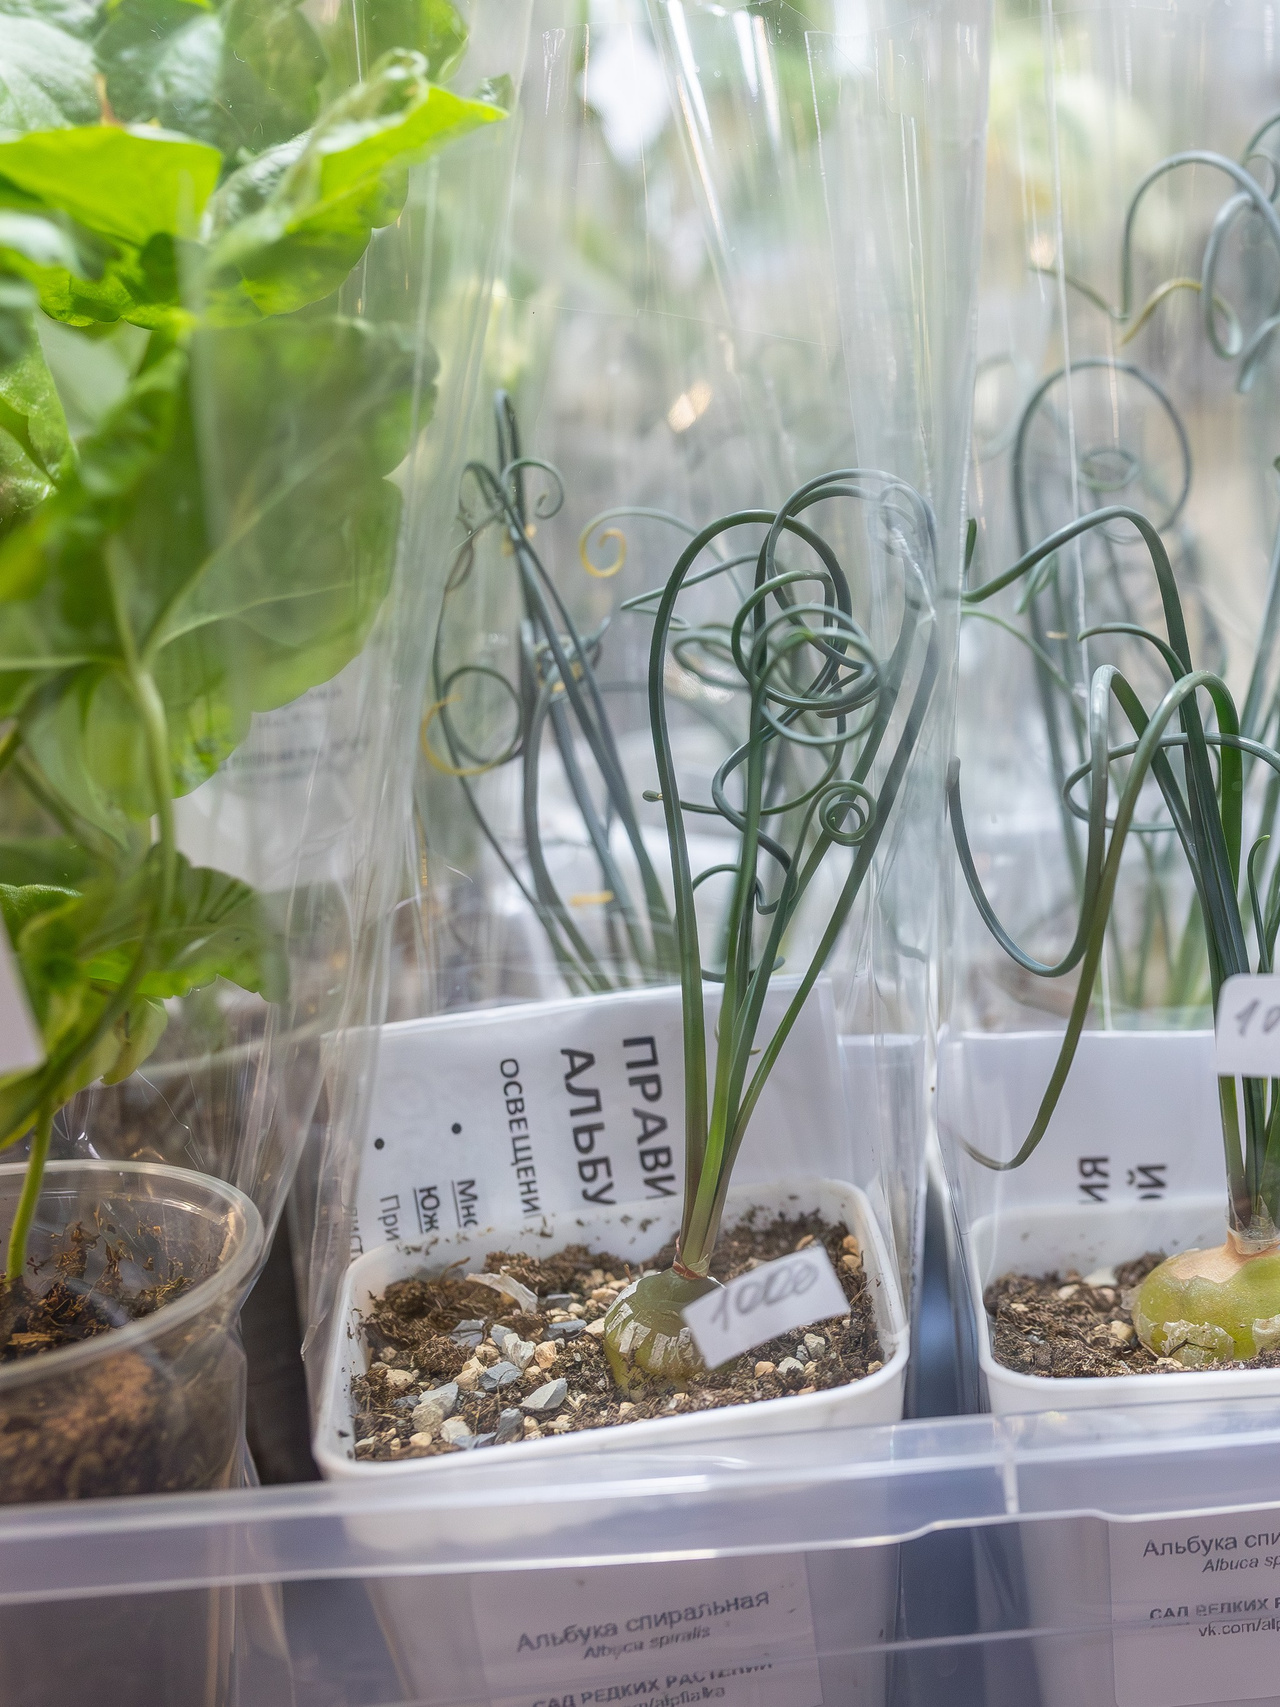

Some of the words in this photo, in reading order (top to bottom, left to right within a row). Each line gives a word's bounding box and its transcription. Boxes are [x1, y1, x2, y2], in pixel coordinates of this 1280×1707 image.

[499, 1058, 541, 1218] ОСВЕЩЕНИ
[710, 1259, 820, 1332] 1000
[1143, 1536, 1238, 1558] Альбука
[1202, 1557, 1260, 1573] Albuca
[516, 1622, 619, 1653] Альбука
[625, 1591, 770, 1633] спиральная
